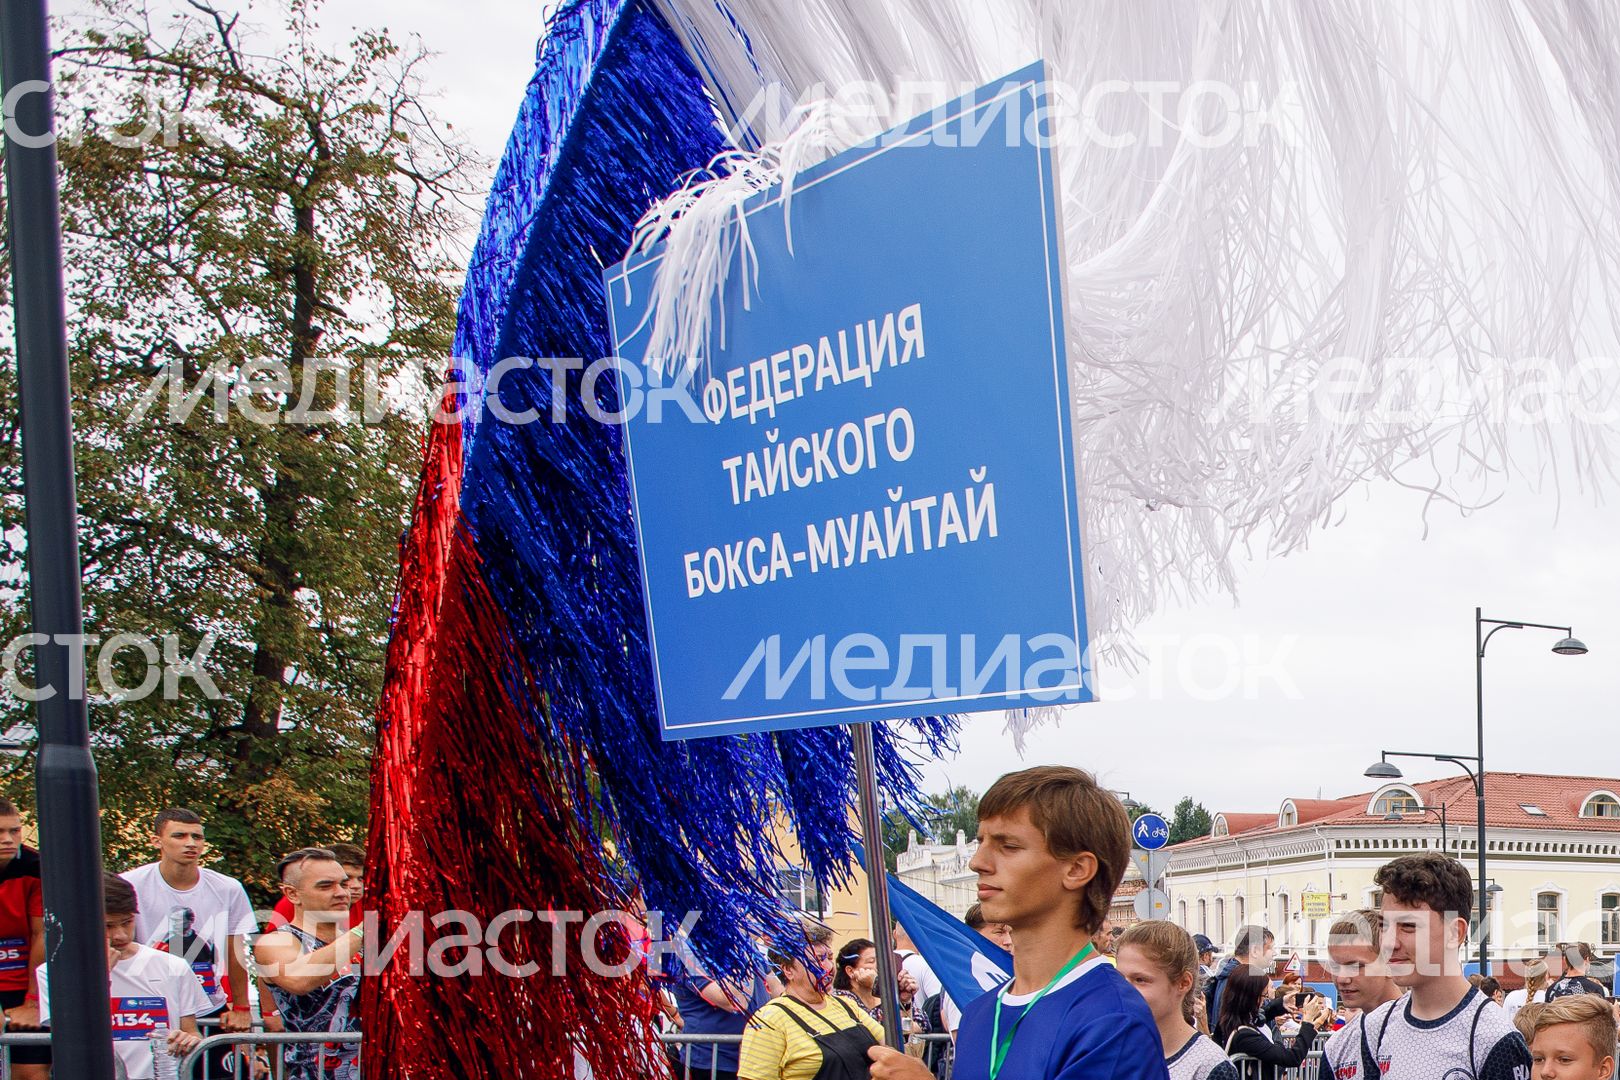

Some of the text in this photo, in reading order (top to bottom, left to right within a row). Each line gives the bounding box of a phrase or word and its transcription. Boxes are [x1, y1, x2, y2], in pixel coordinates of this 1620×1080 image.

[703, 303, 926, 425] ФЕДЕРАЦИЯ
[722, 407, 916, 506] ТАЙСКОГО
[684, 466, 999, 599] БОКСА-МУАЙТАЙ
